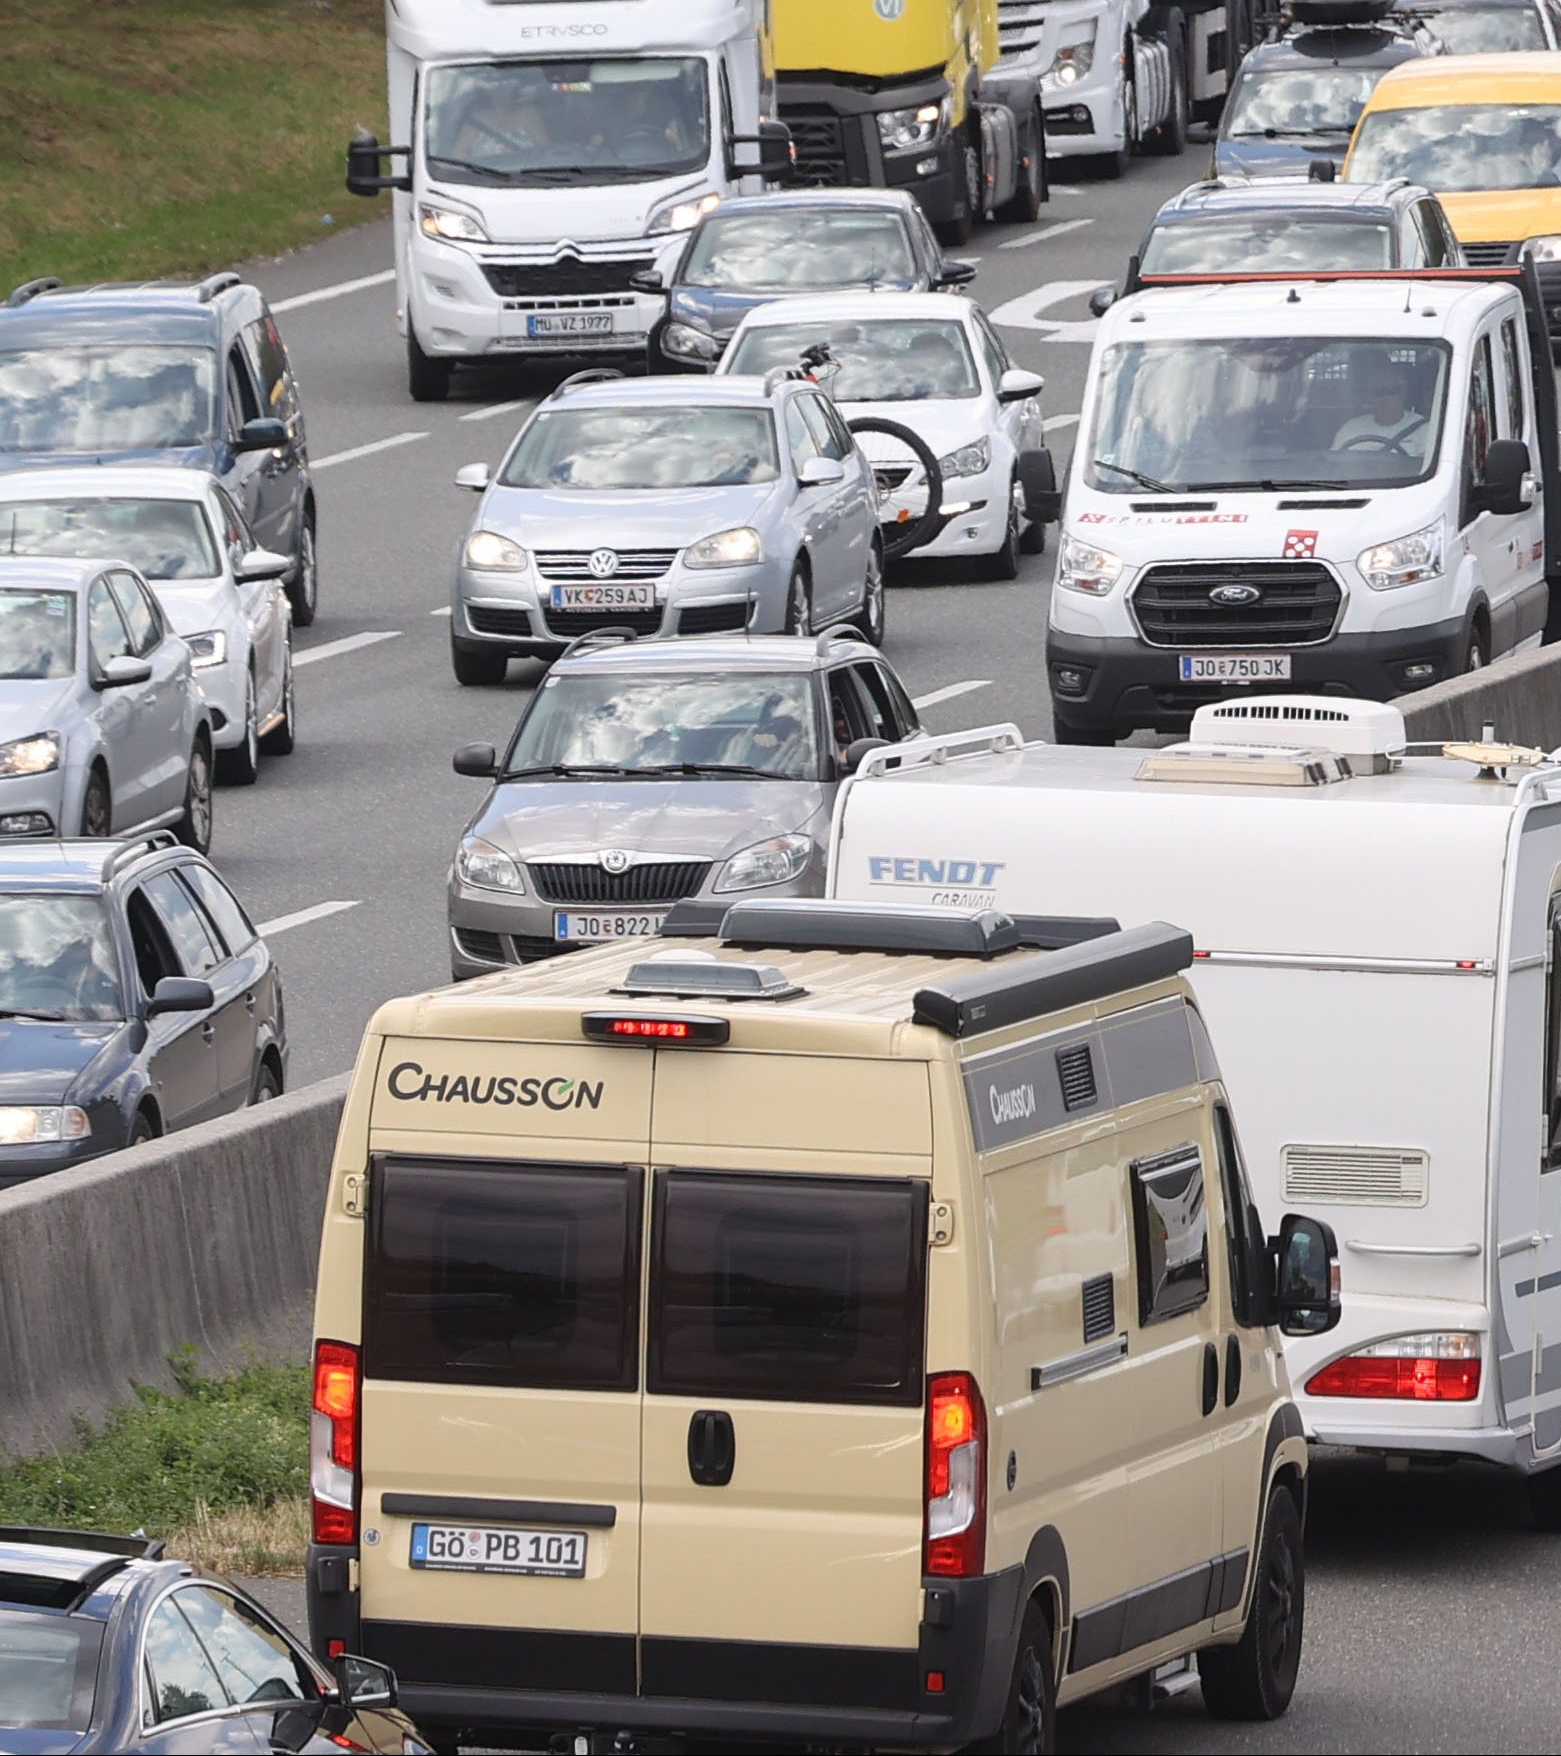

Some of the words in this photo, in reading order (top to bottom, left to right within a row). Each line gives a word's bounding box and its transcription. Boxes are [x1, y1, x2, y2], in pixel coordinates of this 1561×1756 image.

[560, 317, 577, 331] VZ
[579, 315, 610, 330] 1977
[564, 590, 582, 604] VK
[1195, 660, 1215, 676] JO
[1229, 660, 1259, 676] 750
[1264, 659, 1284, 675] JK
[868, 856, 1006, 886] FENDT
[931, 892, 996, 908] CARAVAN
[577, 918, 599, 936] JO
[614, 917, 650, 936] 822
[387, 1061, 604, 1111] CHAUSSON
[989, 1084, 1036, 1125] CHAUSSON
[429, 1531, 464, 1558] GÖ
[485, 1533, 520, 1561] PB
[528, 1536, 580, 1565] 101
